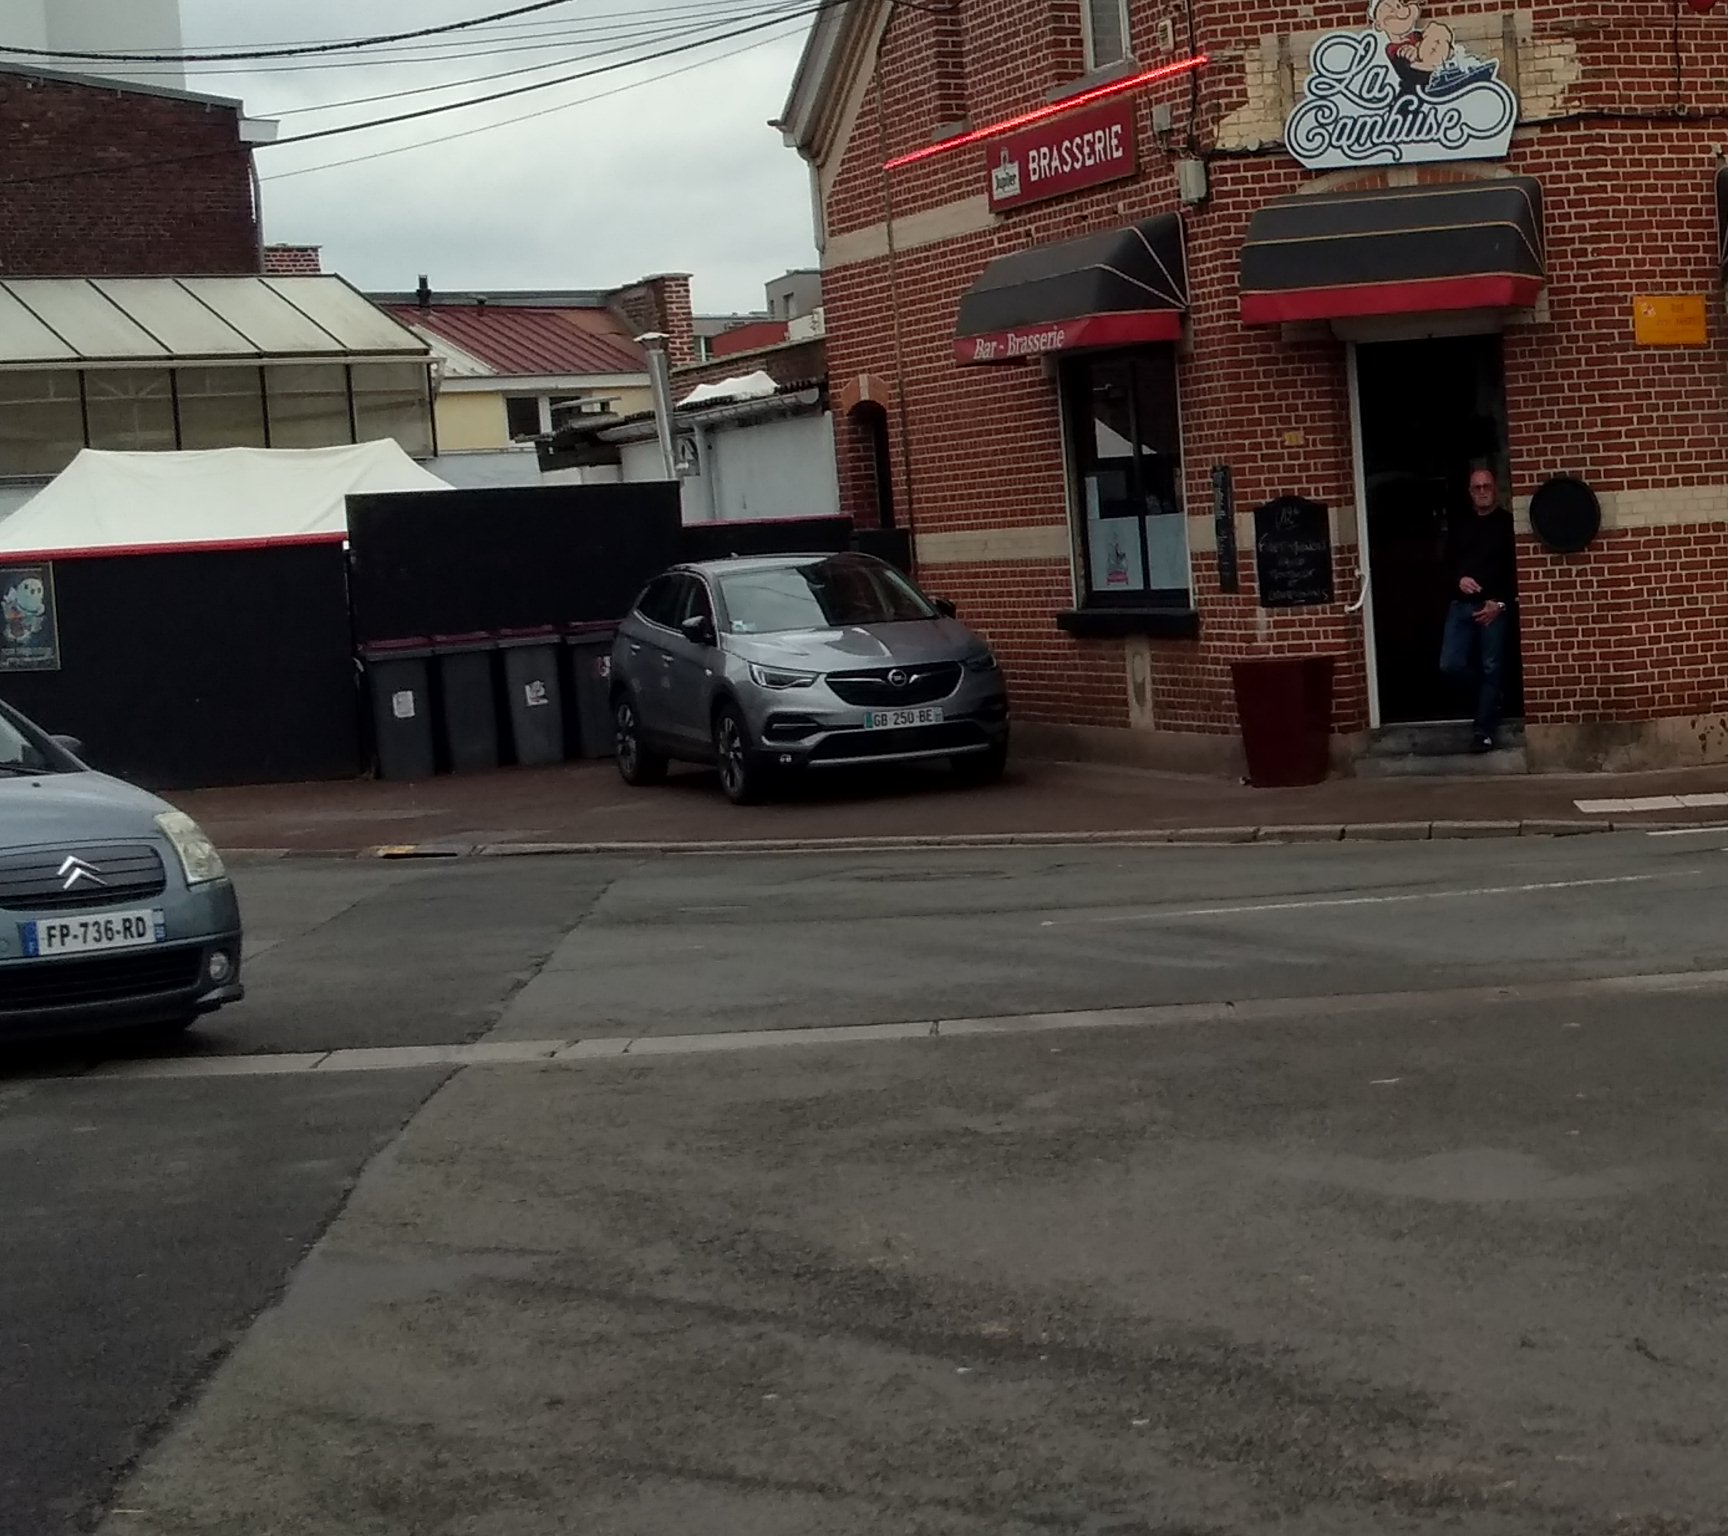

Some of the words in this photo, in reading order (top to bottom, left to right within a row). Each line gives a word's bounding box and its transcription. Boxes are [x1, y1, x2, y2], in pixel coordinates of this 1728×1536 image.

[1308, 32, 1396, 110] La
[1285, 79, 1516, 163] Cambuse
[1028, 124, 1124, 182] BRASSERIE
[973, 338, 997, 359] Bar
[1006, 325, 1065, 356] Brasserie
[874, 714, 888, 726] GB
[893, 712, 914, 725] 250
[918, 709, 933, 722] BE
[46, 916, 147, 948] FP-736-RD
